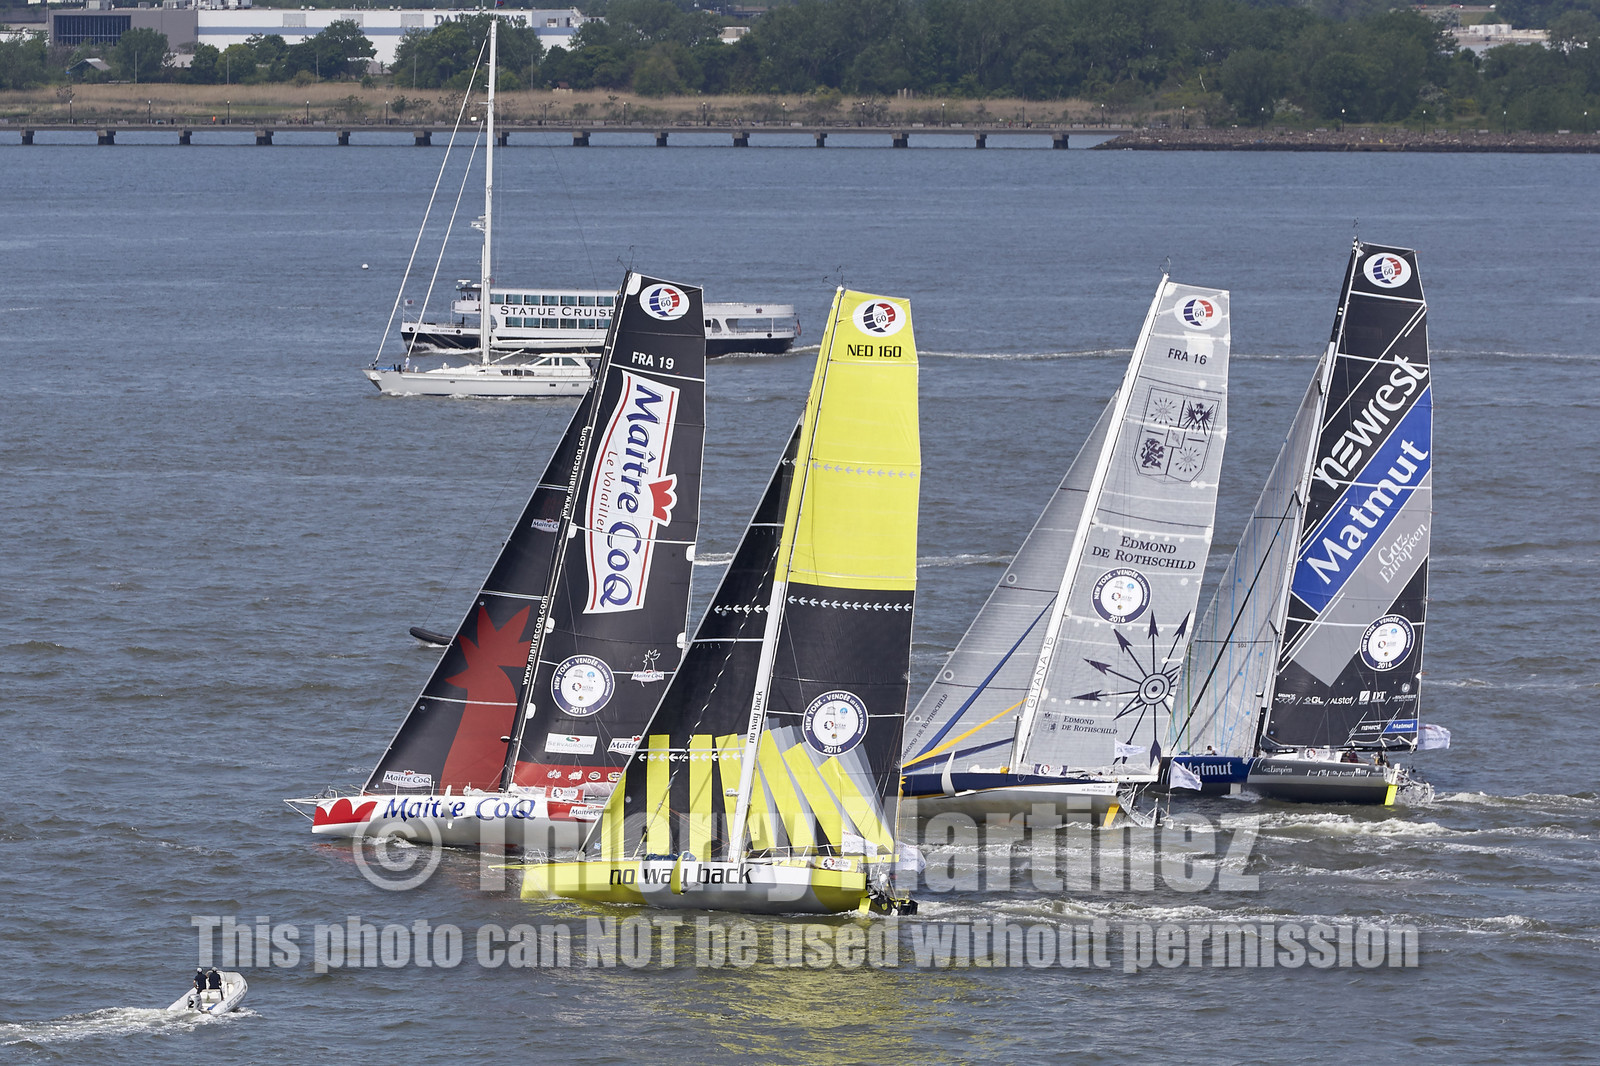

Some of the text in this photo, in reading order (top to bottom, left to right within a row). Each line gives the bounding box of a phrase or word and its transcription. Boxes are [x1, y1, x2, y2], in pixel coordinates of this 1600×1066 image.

[500, 305, 556, 316] STATUE
[847, 344, 902, 358] NED 160
[1168, 348, 1207, 365] FRA 16
[631, 351, 675, 369] FRA 19
[606, 451, 618, 467] Le
[600, 384, 664, 608] Maître CoQ
[1306, 439, 1429, 585] Matmut
[1120, 535, 1177, 554] EDMOND
[1378, 533, 1408, 566] Gaz
[1092, 546, 1196, 570] DE ROTHSCHILD
[1379, 524, 1427, 584] Européen
[1109, 615, 1126, 623] 2016
[557, 662, 571, 676] YORK
[1027, 636, 1054, 709] GITANA 16
[570, 706, 587, 714] 2016
[808, 699, 823, 715] YORK
[921, 693, 948, 729] ROTHSCHILD
[749, 691, 763, 744] no way back
[1063, 715, 1095, 725] EDMOND
[1073, 724, 1118, 735] ROTHSCHILD
[823, 745, 842, 753] 2016
[475, 797, 536, 821] CoQ
[609, 868, 635, 885] no
[696, 863, 753, 885] back
[188, 1000, 195, 1008] 2
